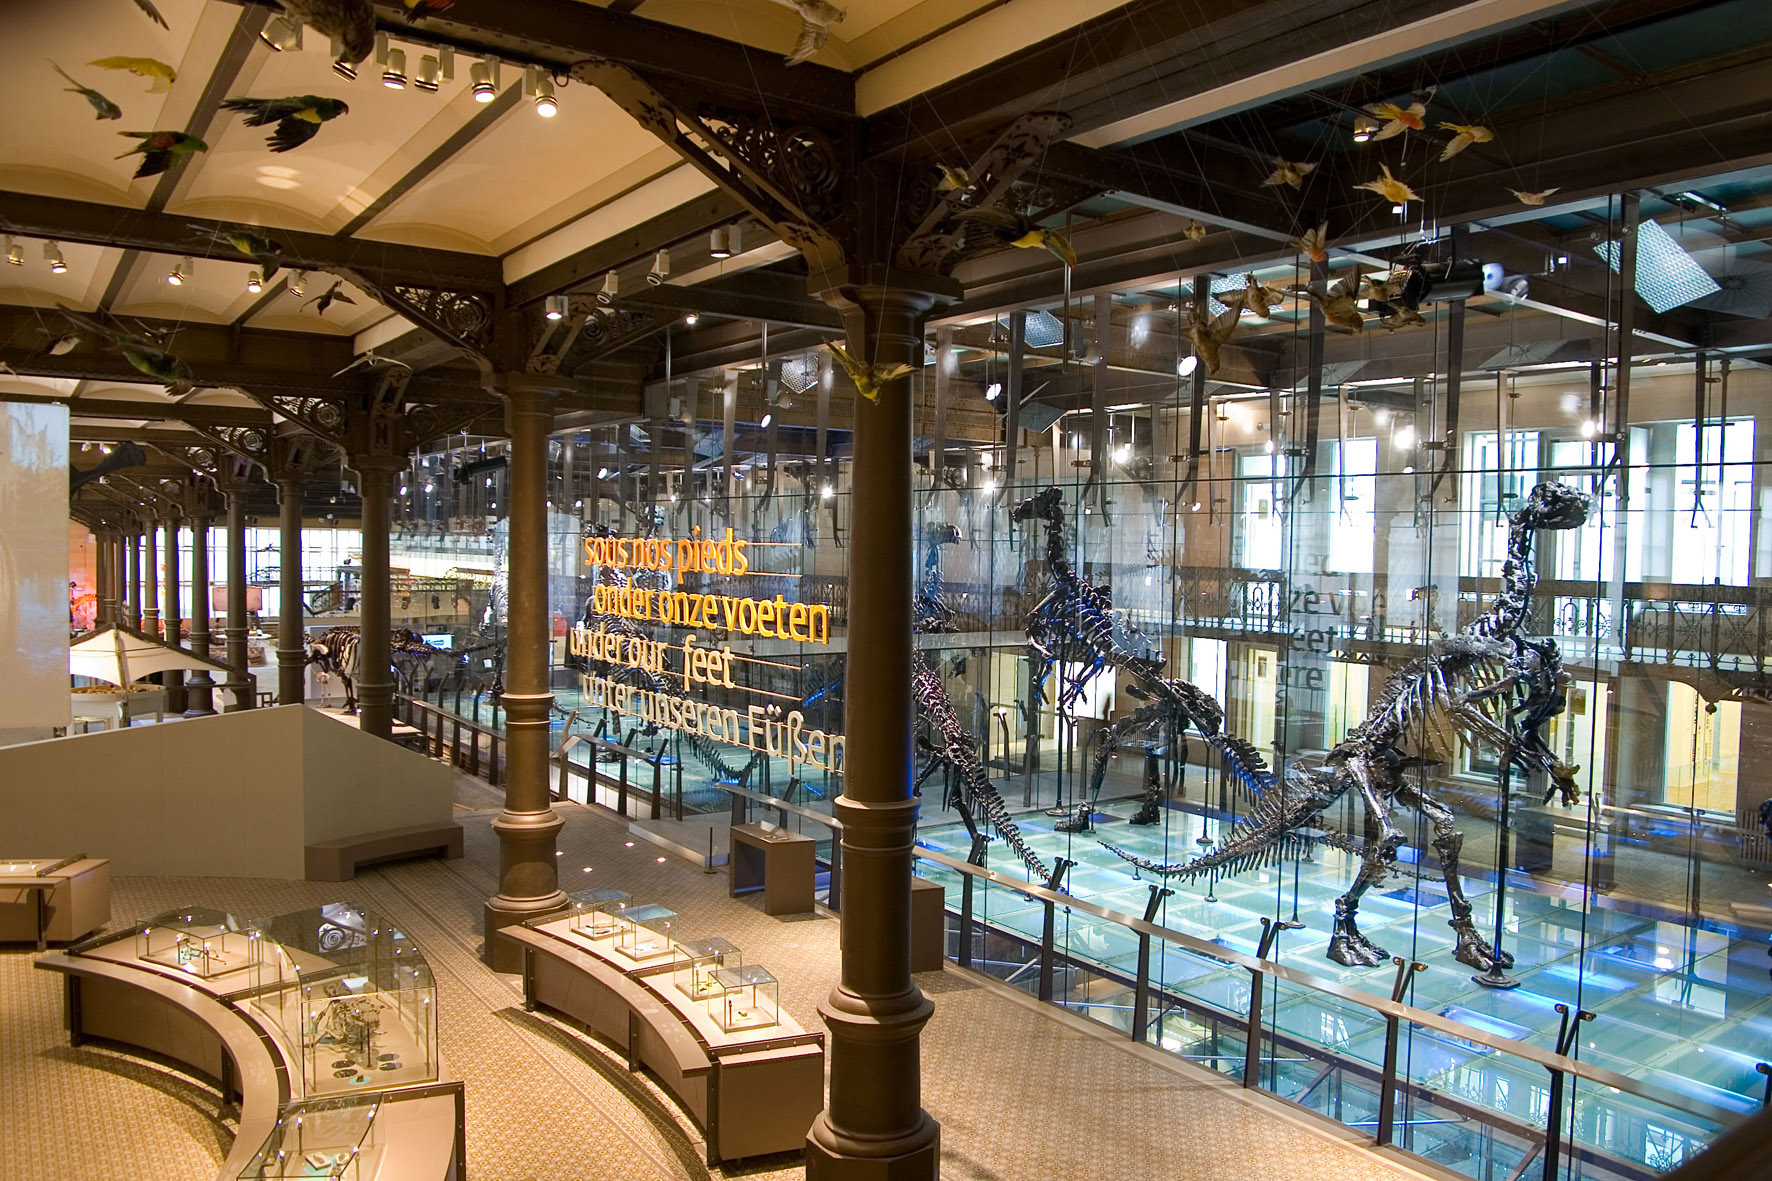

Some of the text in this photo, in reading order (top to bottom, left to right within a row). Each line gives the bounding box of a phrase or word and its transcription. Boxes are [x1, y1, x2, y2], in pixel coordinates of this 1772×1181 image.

[584, 525, 749, 584] sous nos pieds
[595, 578, 829, 644] onder onze voeten
[569, 622, 735, 692] under our feet
[582, 674, 846, 777] unter unseren Füßen
